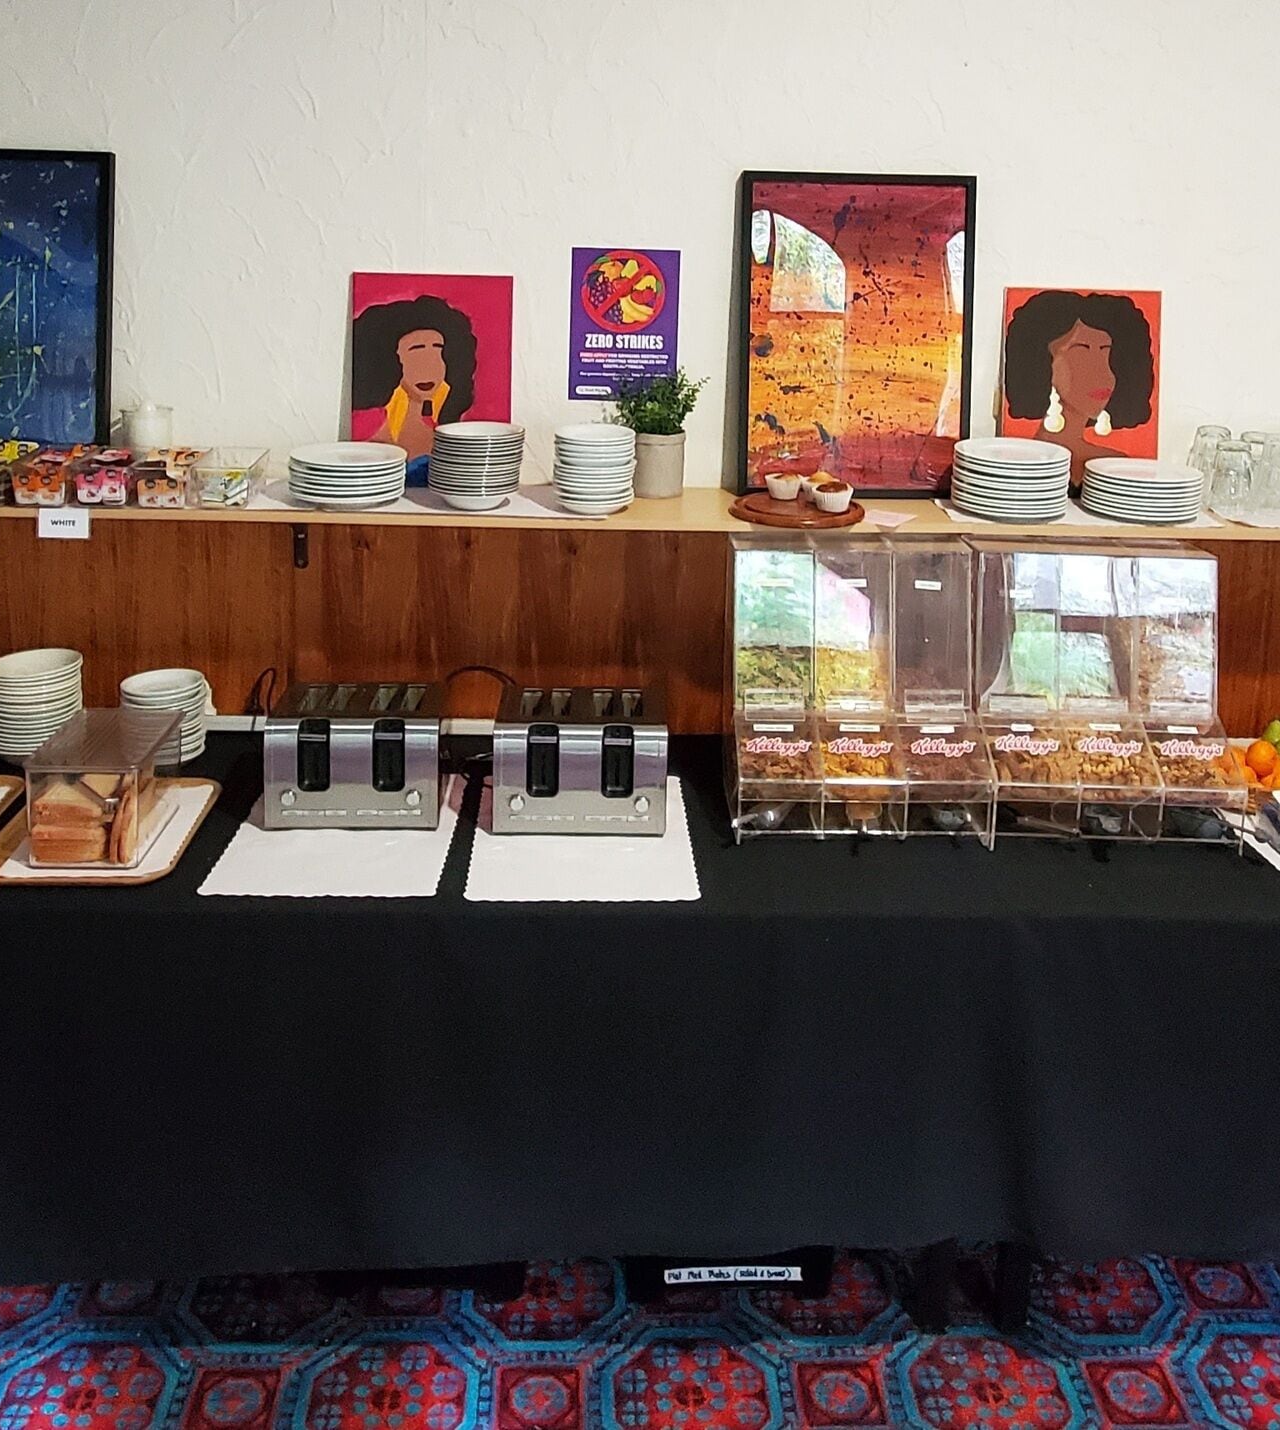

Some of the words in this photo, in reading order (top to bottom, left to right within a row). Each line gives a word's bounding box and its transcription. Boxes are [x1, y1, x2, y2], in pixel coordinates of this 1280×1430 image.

[585, 333, 613, 348] ZERO
[615, 335, 664, 350] STRIKES
[748, 737, 809, 756] Kellogg's
[830, 738, 891, 757] Kellogg's
[912, 738, 974, 756] Kellogg's
[996, 736, 1058, 754] Kellogg's
[1079, 737, 1141, 755] Kellogg's
[1161, 739, 1223, 758] Kellogg's
